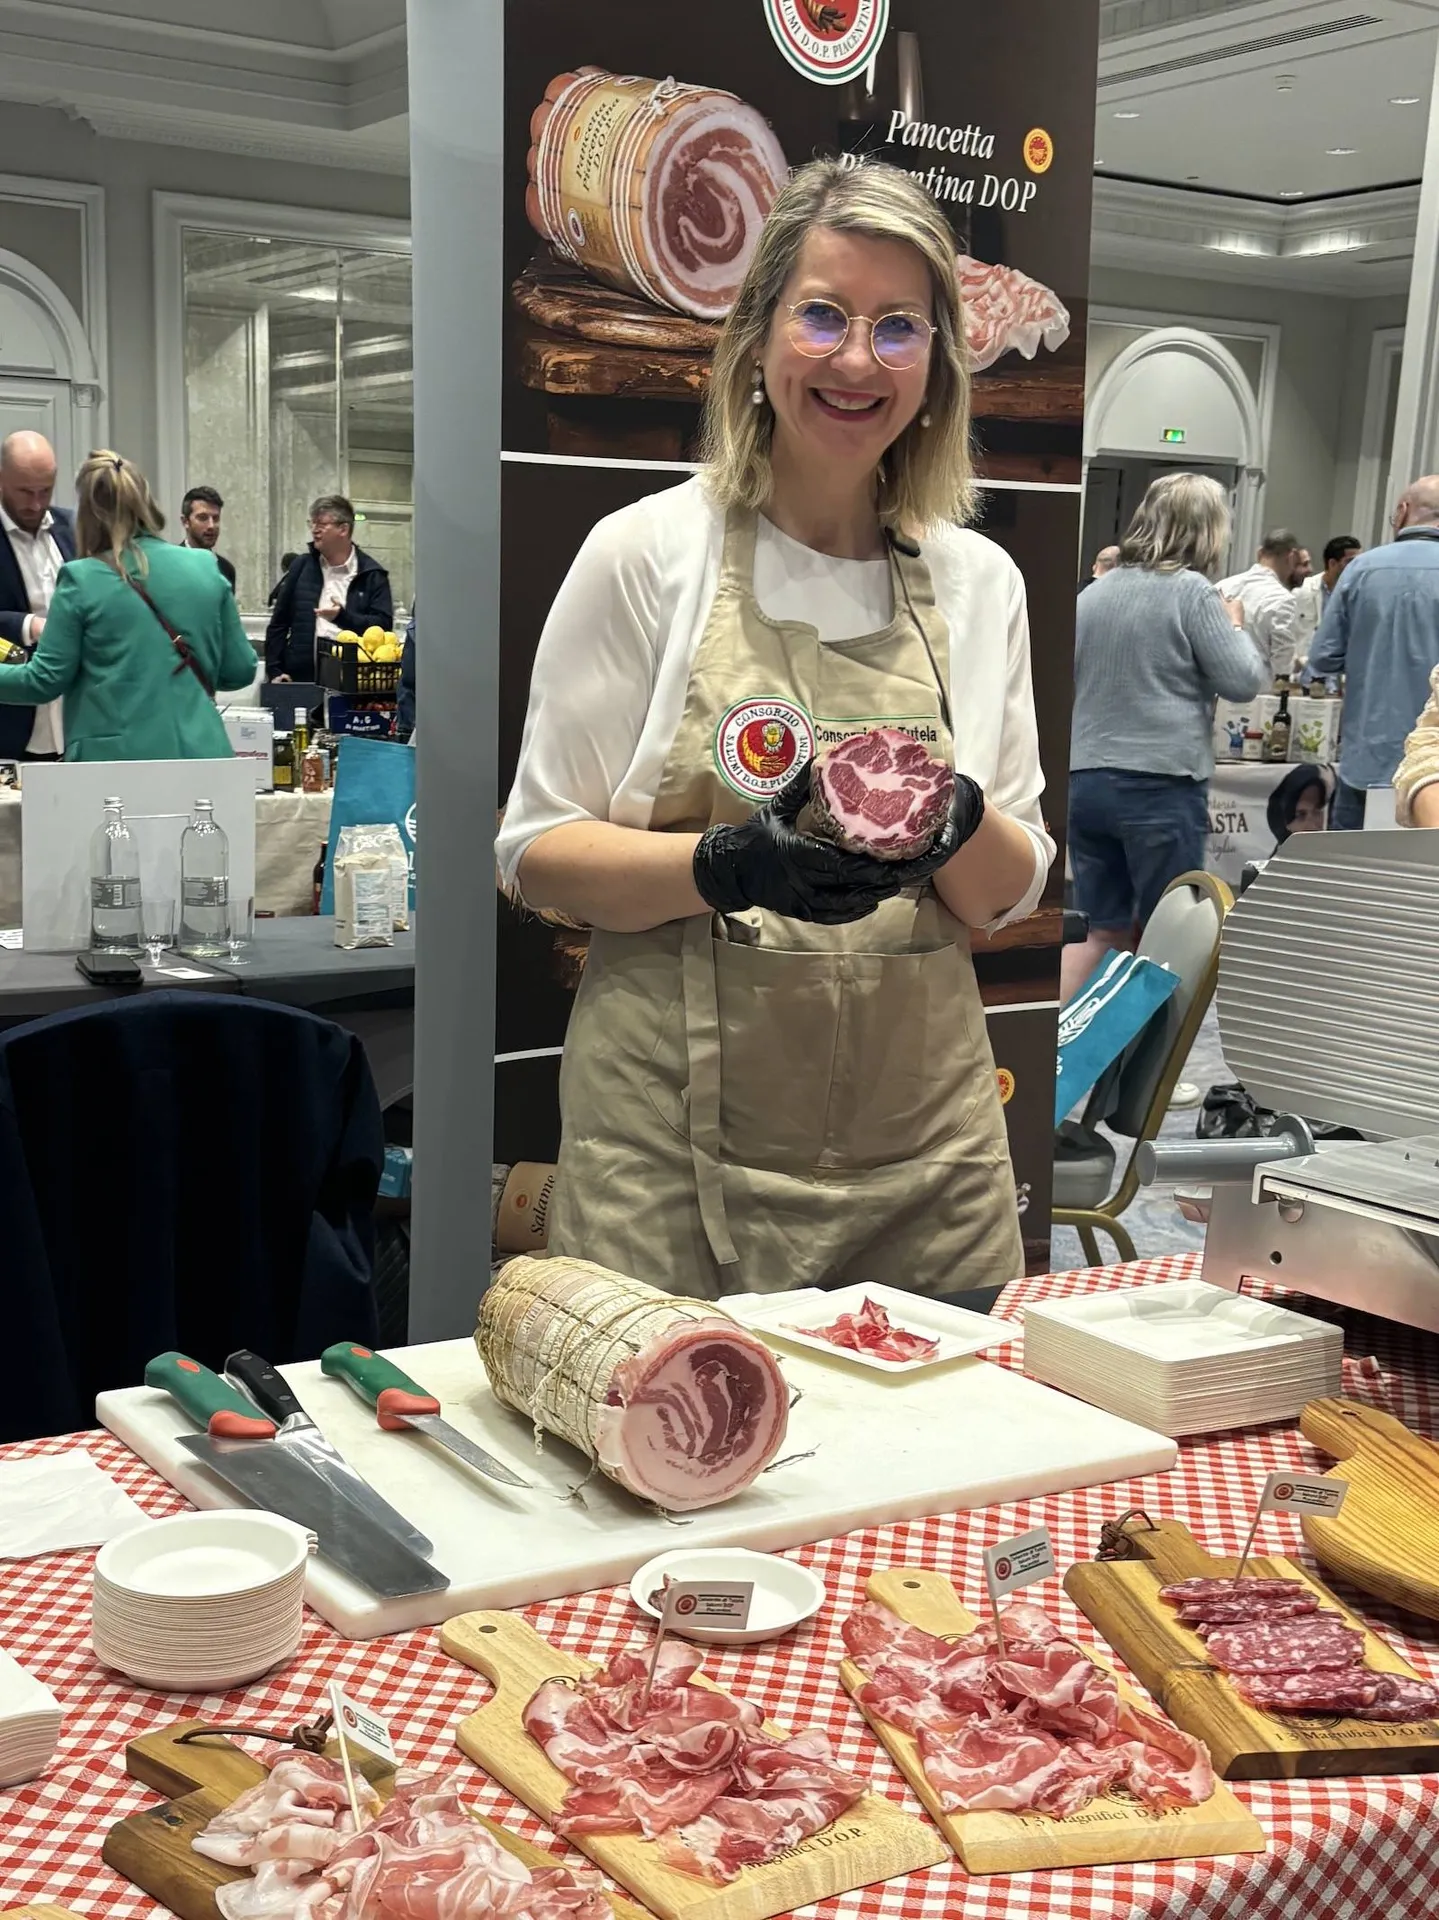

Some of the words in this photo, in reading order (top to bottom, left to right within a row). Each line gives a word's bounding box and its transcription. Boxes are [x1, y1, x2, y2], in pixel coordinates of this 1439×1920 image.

[832, 0, 871, 58] PIACENTIN
[885, 109, 996, 160] Pancetta
[840, 151, 976, 205] Ptina
[978, 174, 1037, 213] DOP
[735, 706, 800, 728] CONSORZIO
[814, 724, 868, 743] Conso
[725, 734, 741, 776] SALUMI
[1207, 812, 1249, 834] ASTA
[531, 1174, 555, 1236] Salame
[1134, 1805, 1188, 1819] DO.P.
[816, 1827, 867, 1848] D.O.P.
